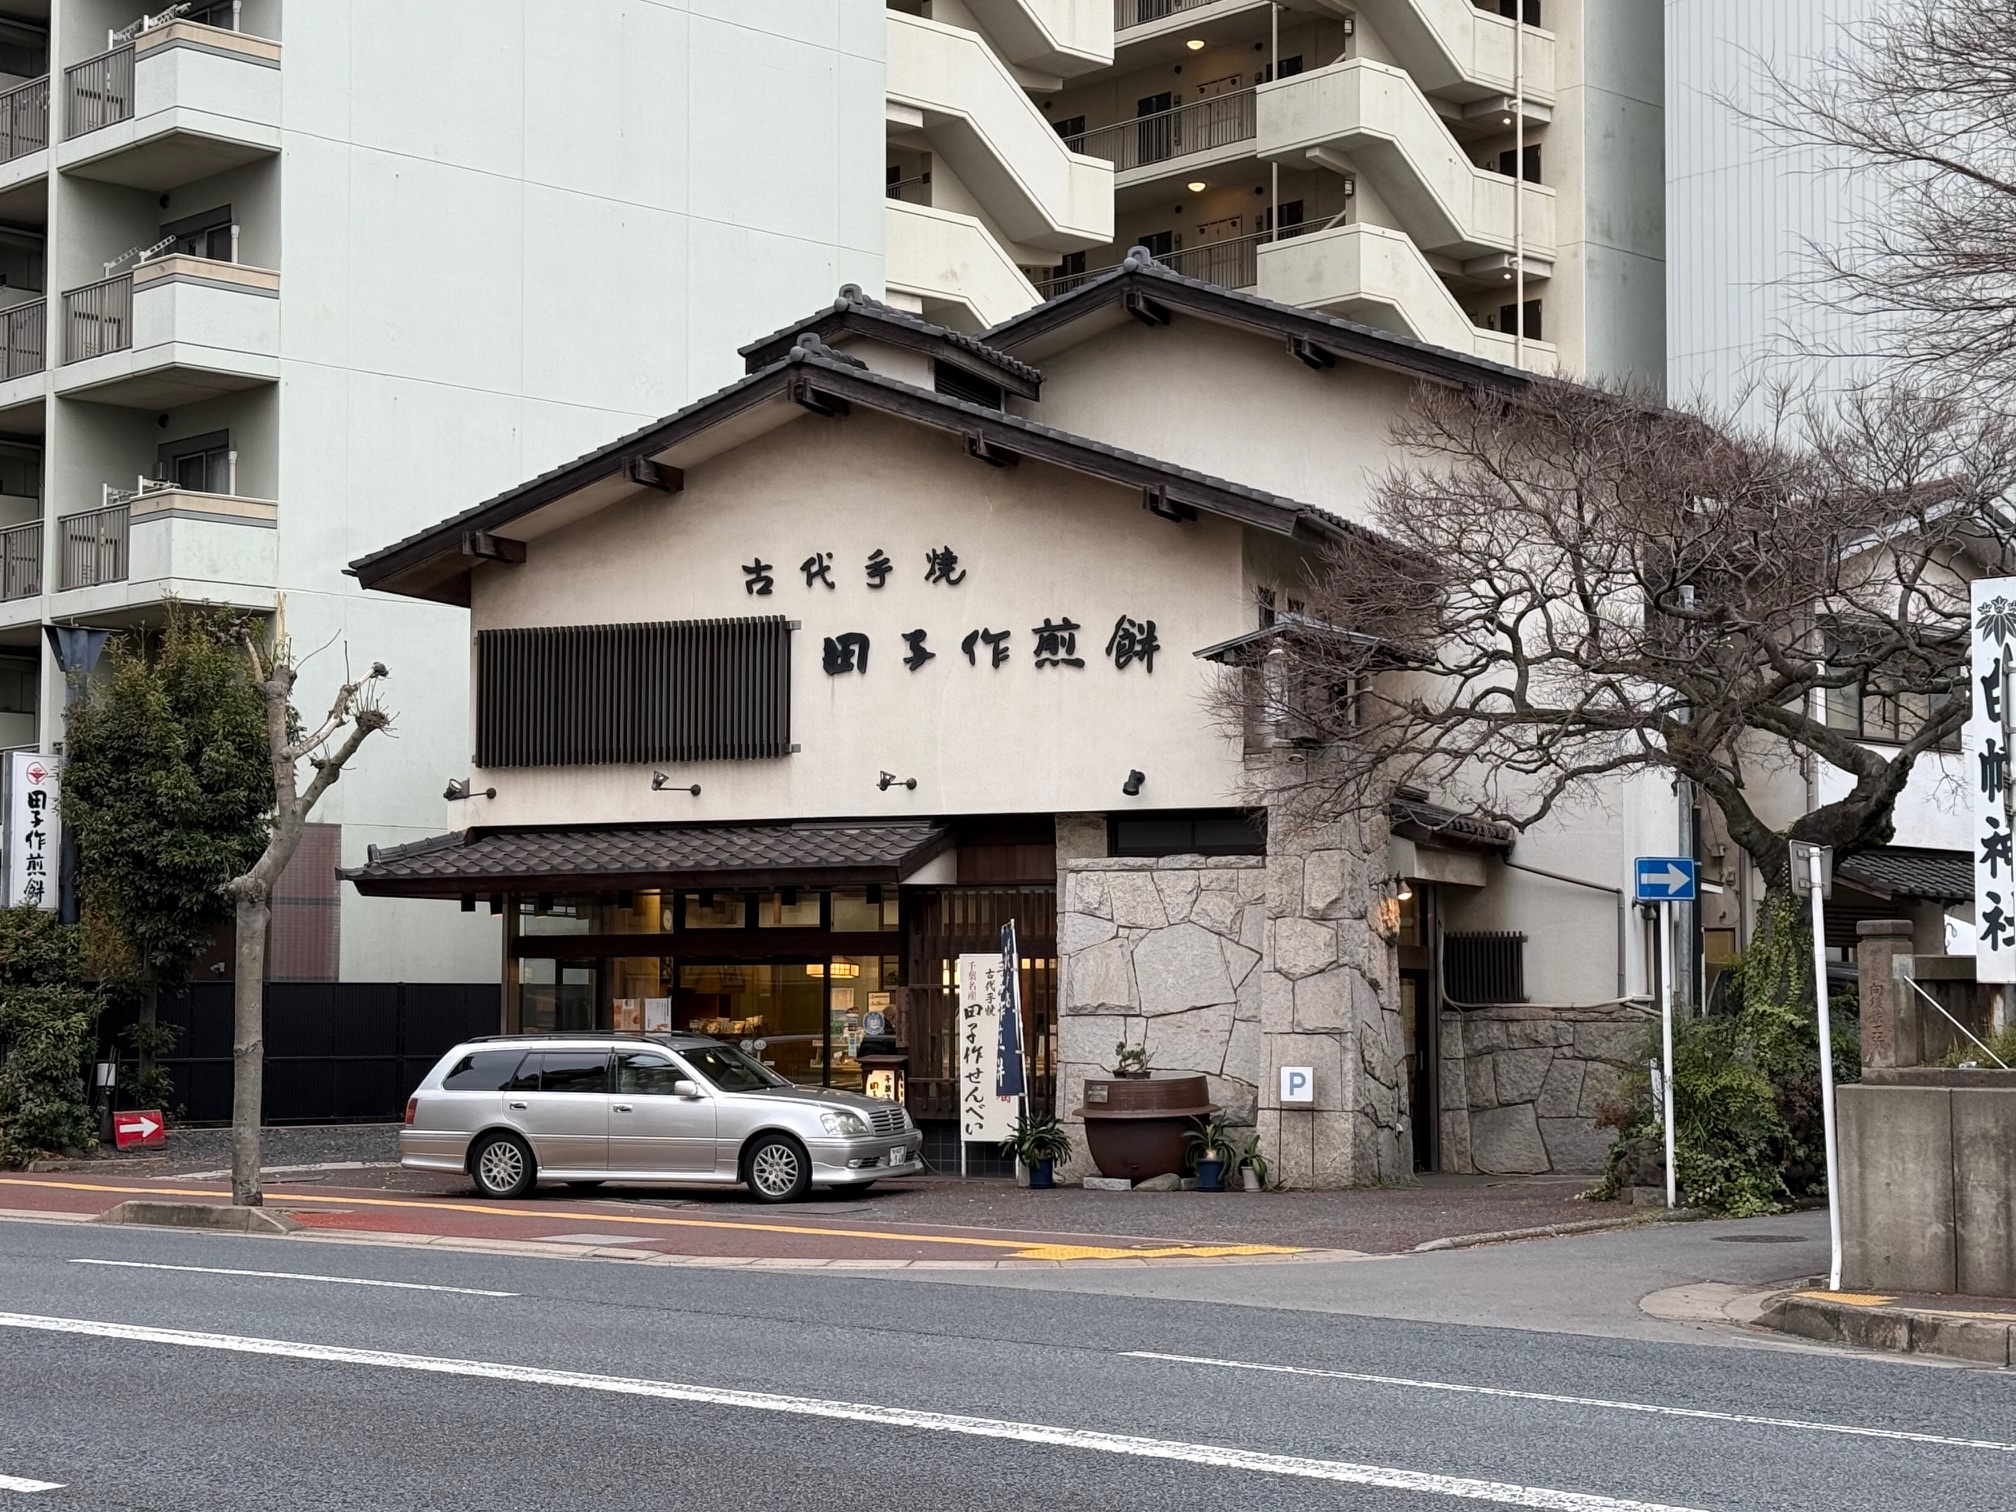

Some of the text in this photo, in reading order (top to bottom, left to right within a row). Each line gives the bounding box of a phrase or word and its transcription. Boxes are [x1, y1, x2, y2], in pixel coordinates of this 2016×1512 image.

[822, 614, 1161, 675] 田子作煎餅
[24, 790, 47, 903] 田子作煎餅
[963, 1003, 985, 1136] 田子作せんべい
[1289, 1072, 1306, 1096] P
